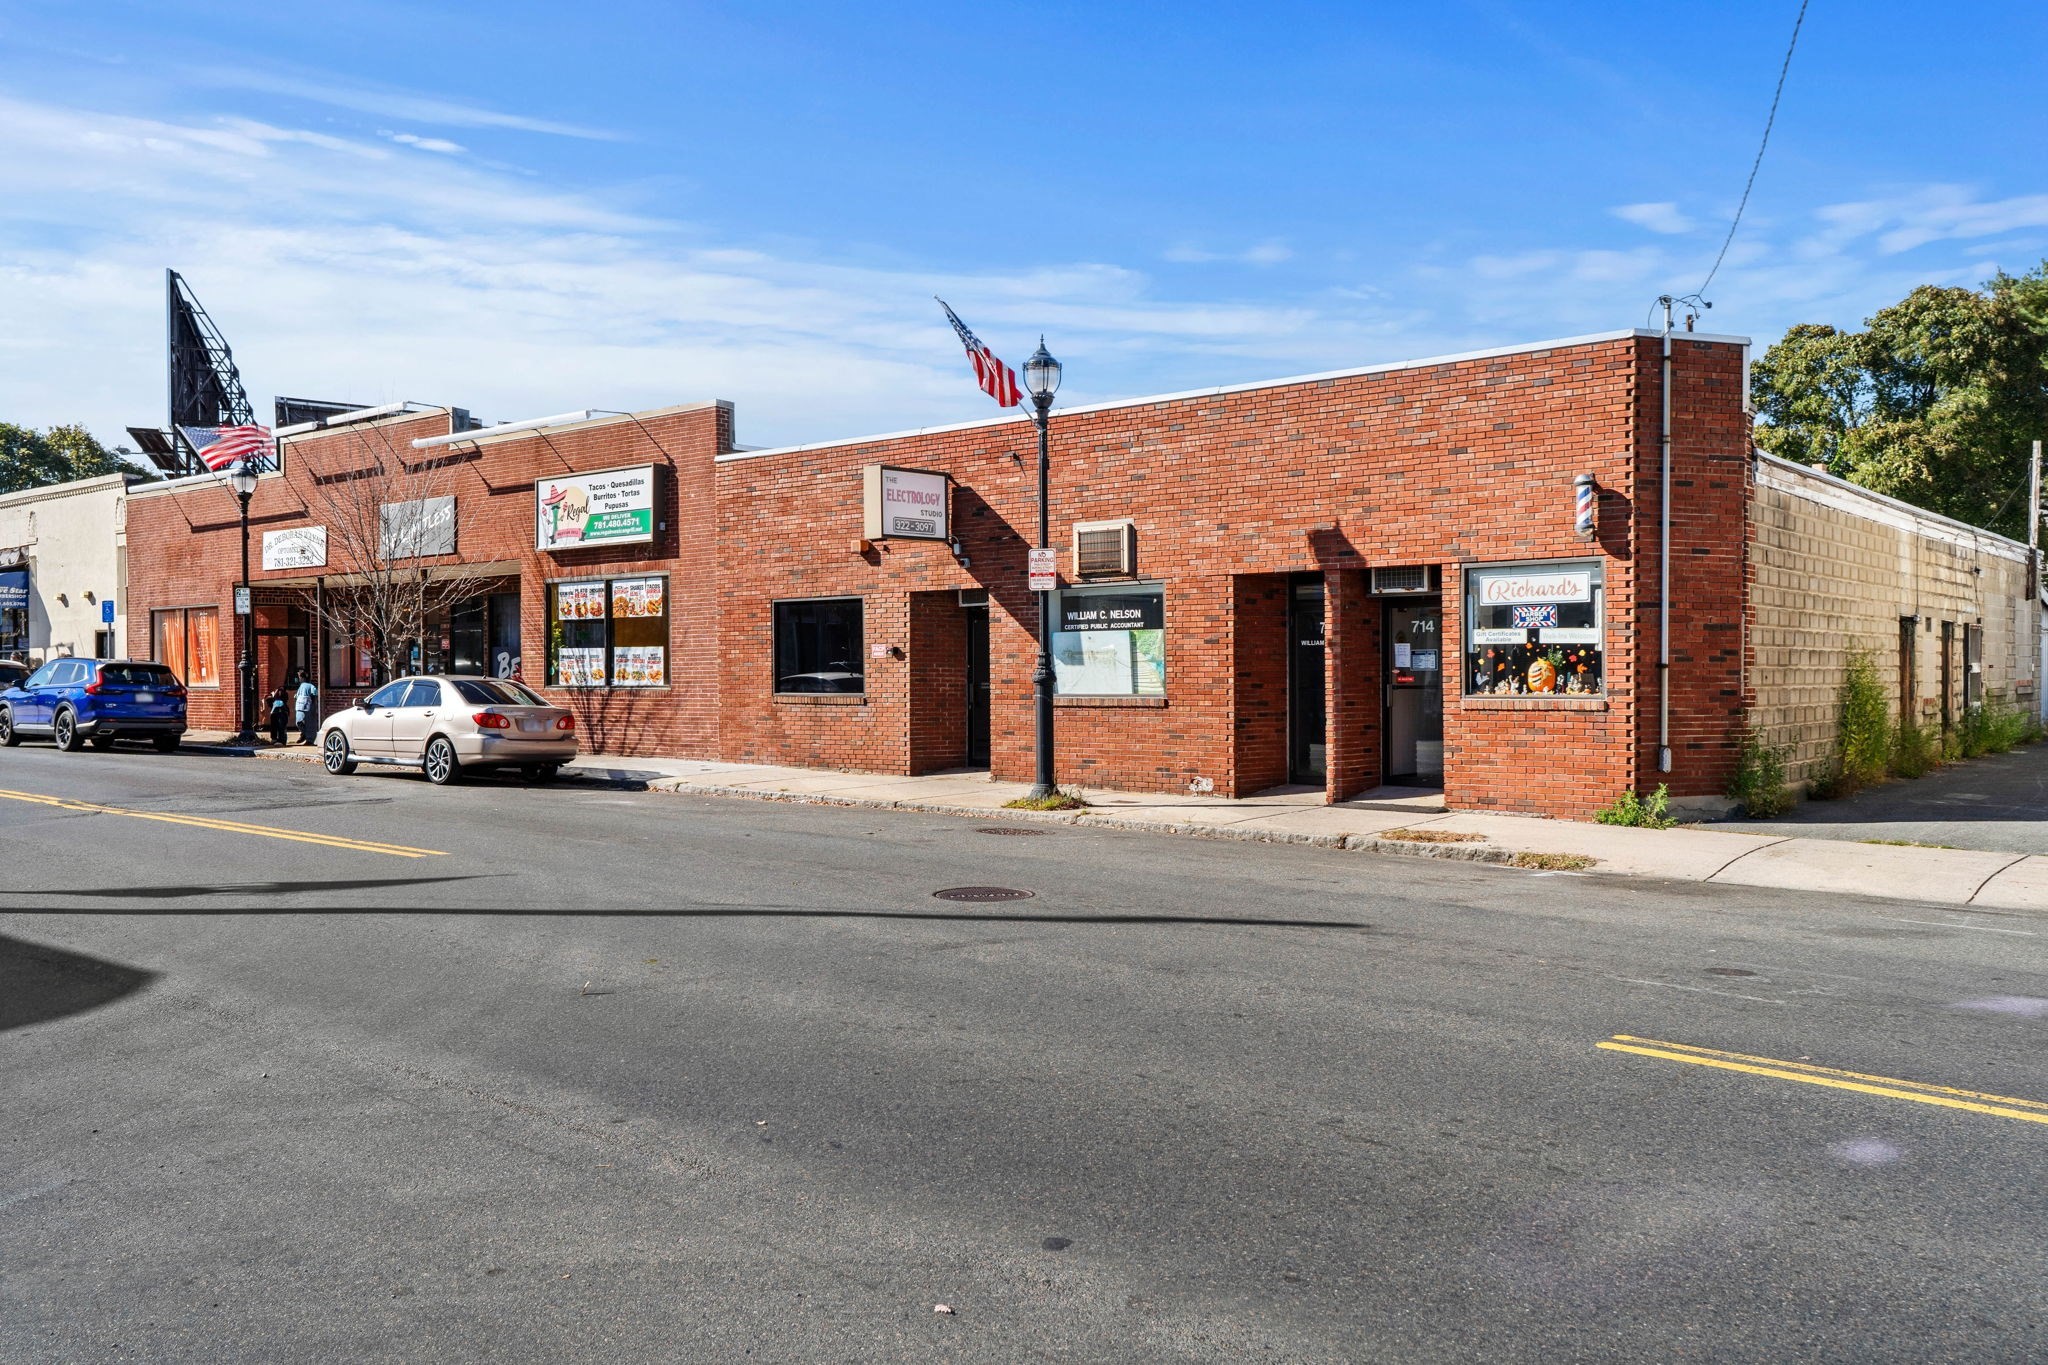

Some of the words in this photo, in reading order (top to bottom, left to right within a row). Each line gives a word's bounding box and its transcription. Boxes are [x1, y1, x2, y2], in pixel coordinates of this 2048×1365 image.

[610, 478, 645, 489] Quesadillas
[621, 489, 641, 497] Tortas
[886, 488, 941, 506] ELECTROLOGY
[566, 495, 590, 522] Regal
[604, 502, 629, 510] Pupusas
[920, 509, 943, 518] STUDIO
[594, 518, 640, 529] 781.480.4571
[895, 520, 934, 532] 322-3097
[1488, 579, 1582, 601] Richard's
[1067, 610, 1097, 620] WILLIAM
[1100, 610, 1108, 619] C.
[1110, 610, 1142, 619] NELSON
[1411, 620, 1435, 633] 714
